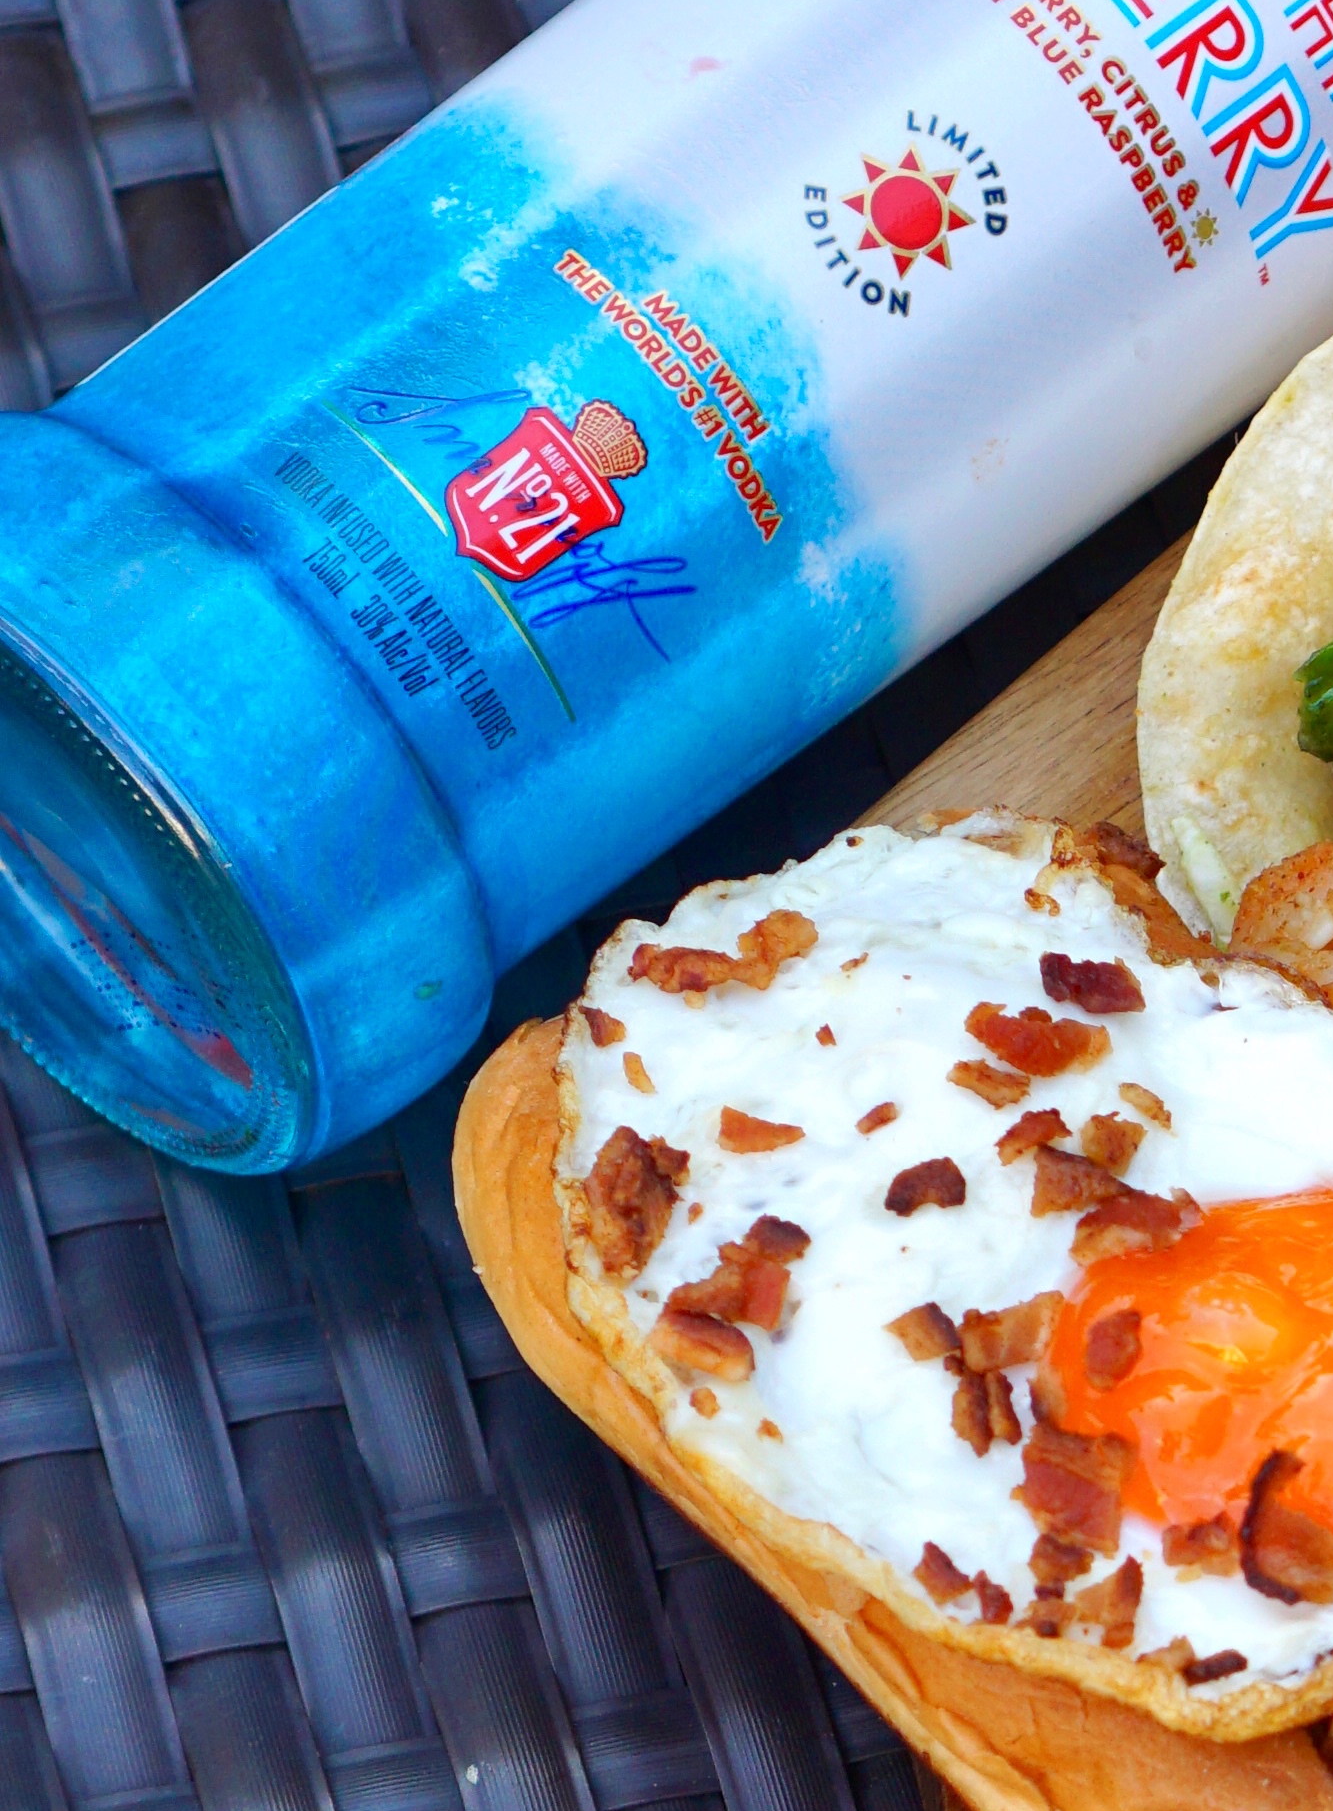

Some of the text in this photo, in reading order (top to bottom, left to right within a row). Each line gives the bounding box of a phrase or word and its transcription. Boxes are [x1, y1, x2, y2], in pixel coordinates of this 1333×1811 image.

[907, 109, 1008, 237] LIMITED
[1009, 7, 1085, 86] BLUE
[1078, 83, 1197, 274] RASPBERRY
[1101, 55, 1186, 178] CITRUS
[1176, 178, 1201, 211] &
[803, 184, 911, 317] EDITION
[553, 247, 783, 544] THE WORLD'S #1 VODKA
[643, 289, 770, 443] MADE WITH
[538, 443, 592, 504] MADE WITH
[275, 451, 519, 751] VODKA INFUSED WITH NATURAL FLAVORS
[350, 594, 391, 641] 30%
[375, 627, 440, 698] Alc/Vol
